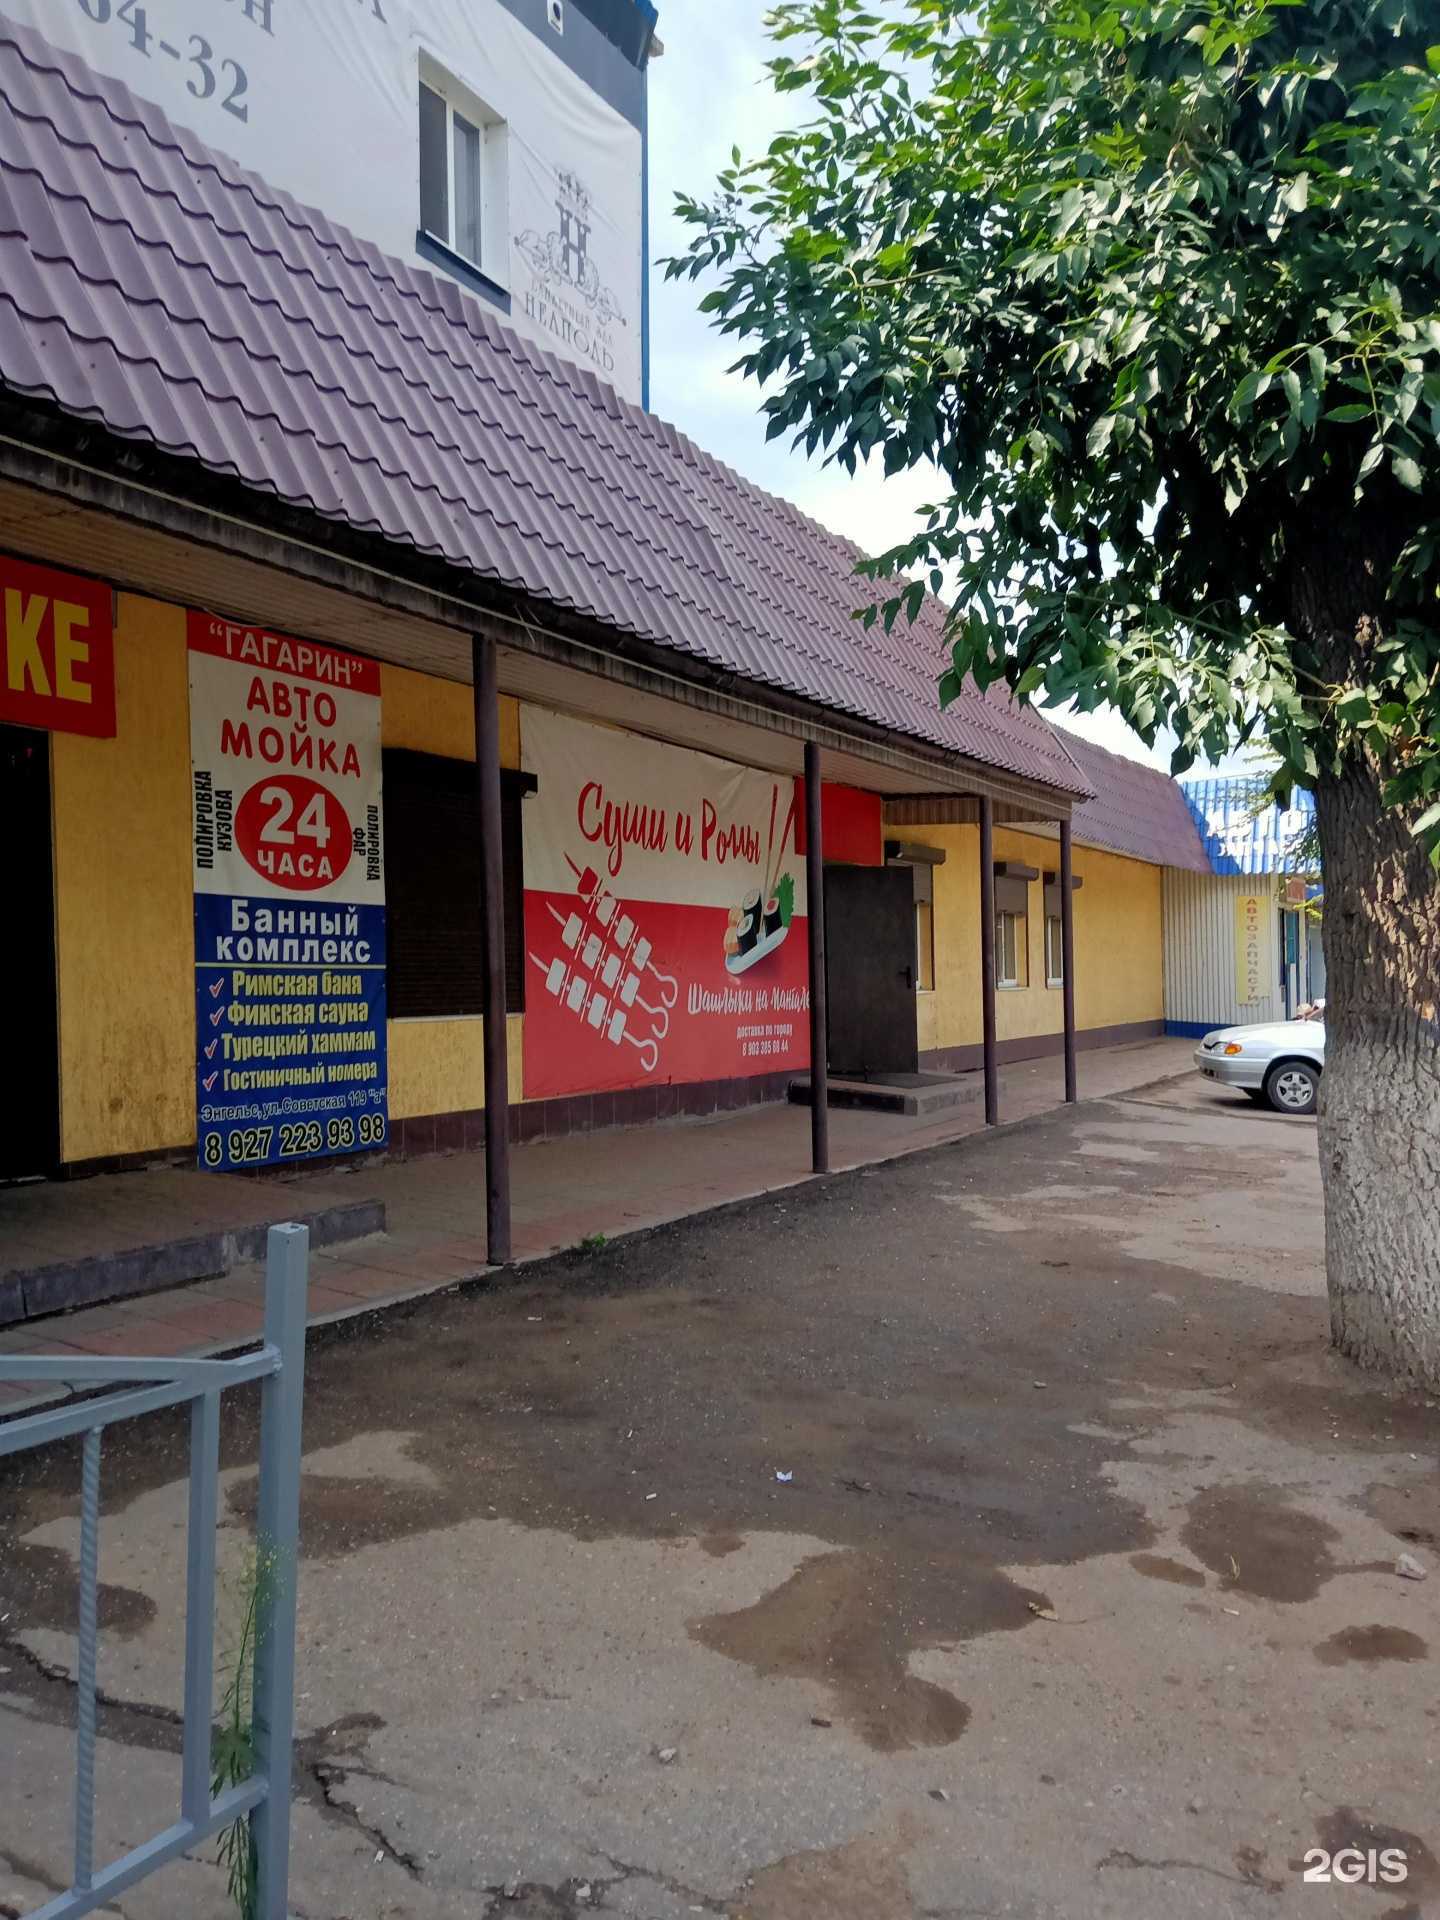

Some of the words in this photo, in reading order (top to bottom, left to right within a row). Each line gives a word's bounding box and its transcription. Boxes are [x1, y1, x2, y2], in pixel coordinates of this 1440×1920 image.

[525, 291, 614, 371] НЕАПОЛЬ
[5, 587, 92, 704] КЕ
[247, 676, 337, 727] АВТО
[220, 719, 361, 778] МОЙКА
[194, 771, 214, 869] ПОЛИРОВКА
[214, 790, 233, 852] КУЗОВА
[259, 786, 331, 848] 24
[578, 781, 668, 877] Суши
[675, 811, 694, 856] и
[352, 827, 366, 856] ФАР
[366, 804, 380, 881] ПОЛИРОВКА
[257, 849, 333, 880] ЧАСА
[231, 898, 359, 936] Банный
[216, 935, 371, 964] комплекс
[232, 970, 318, 997] Римская
[321, 971, 362, 996] баня
[688, 982, 753, 1015] Шашлыки
[755, 988, 769, 1011] на
[227, 1000, 314, 1027] Финская
[318, 1001, 369, 1026] сауна
[221, 1028, 308, 1062] Турецкий
[311, 1030, 376, 1053] хаммам
[737, 1025, 764, 1040] доставка
[766, 1024, 773, 1036] по
[774, 1024, 792, 1038] городу
[742, 1042, 747, 1056] 8
[223, 1061, 325, 1091] Гостиничный
[328, 1061, 377, 1083] номера
[348, 1090, 367, 1107] 119
[205, 1132, 221, 1166] 8
[229, 1126, 273, 1163] 927
[279, 1121, 322, 1157] 223
[327, 1117, 354, 1149] 93
[359, 1113, 385, 1144] 98
